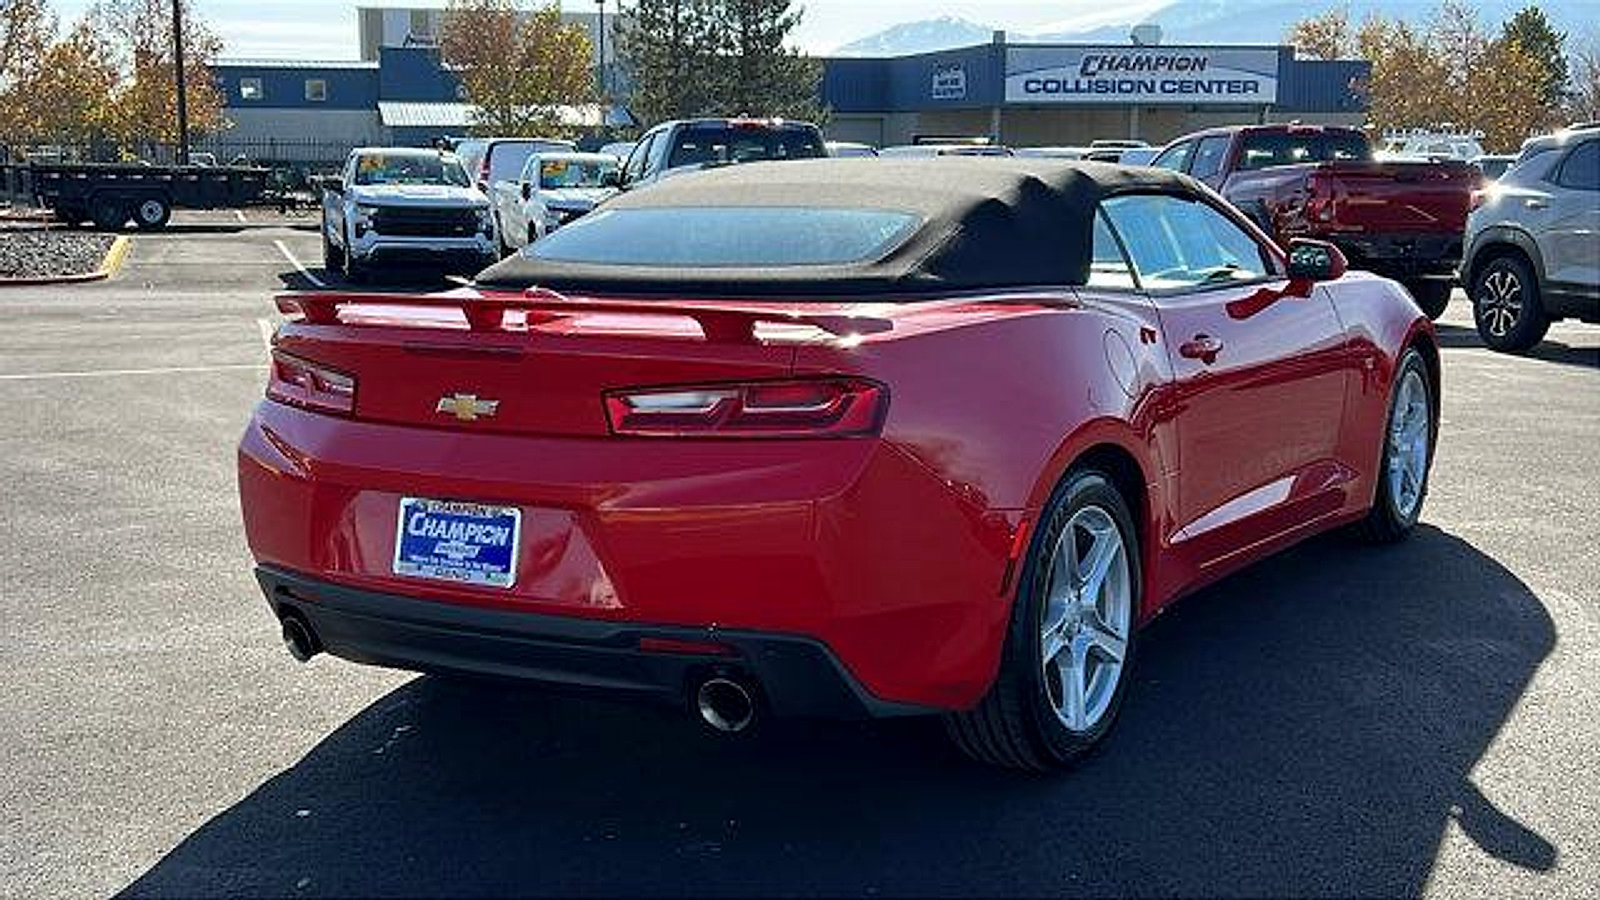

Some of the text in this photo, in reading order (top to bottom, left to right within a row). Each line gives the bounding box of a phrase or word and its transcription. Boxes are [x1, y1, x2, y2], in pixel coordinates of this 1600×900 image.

[1081, 54, 1208, 76] CHAMPION
[1024, 79, 1259, 94] COLLISION CENTER
[408, 512, 510, 546] CHAMPION
